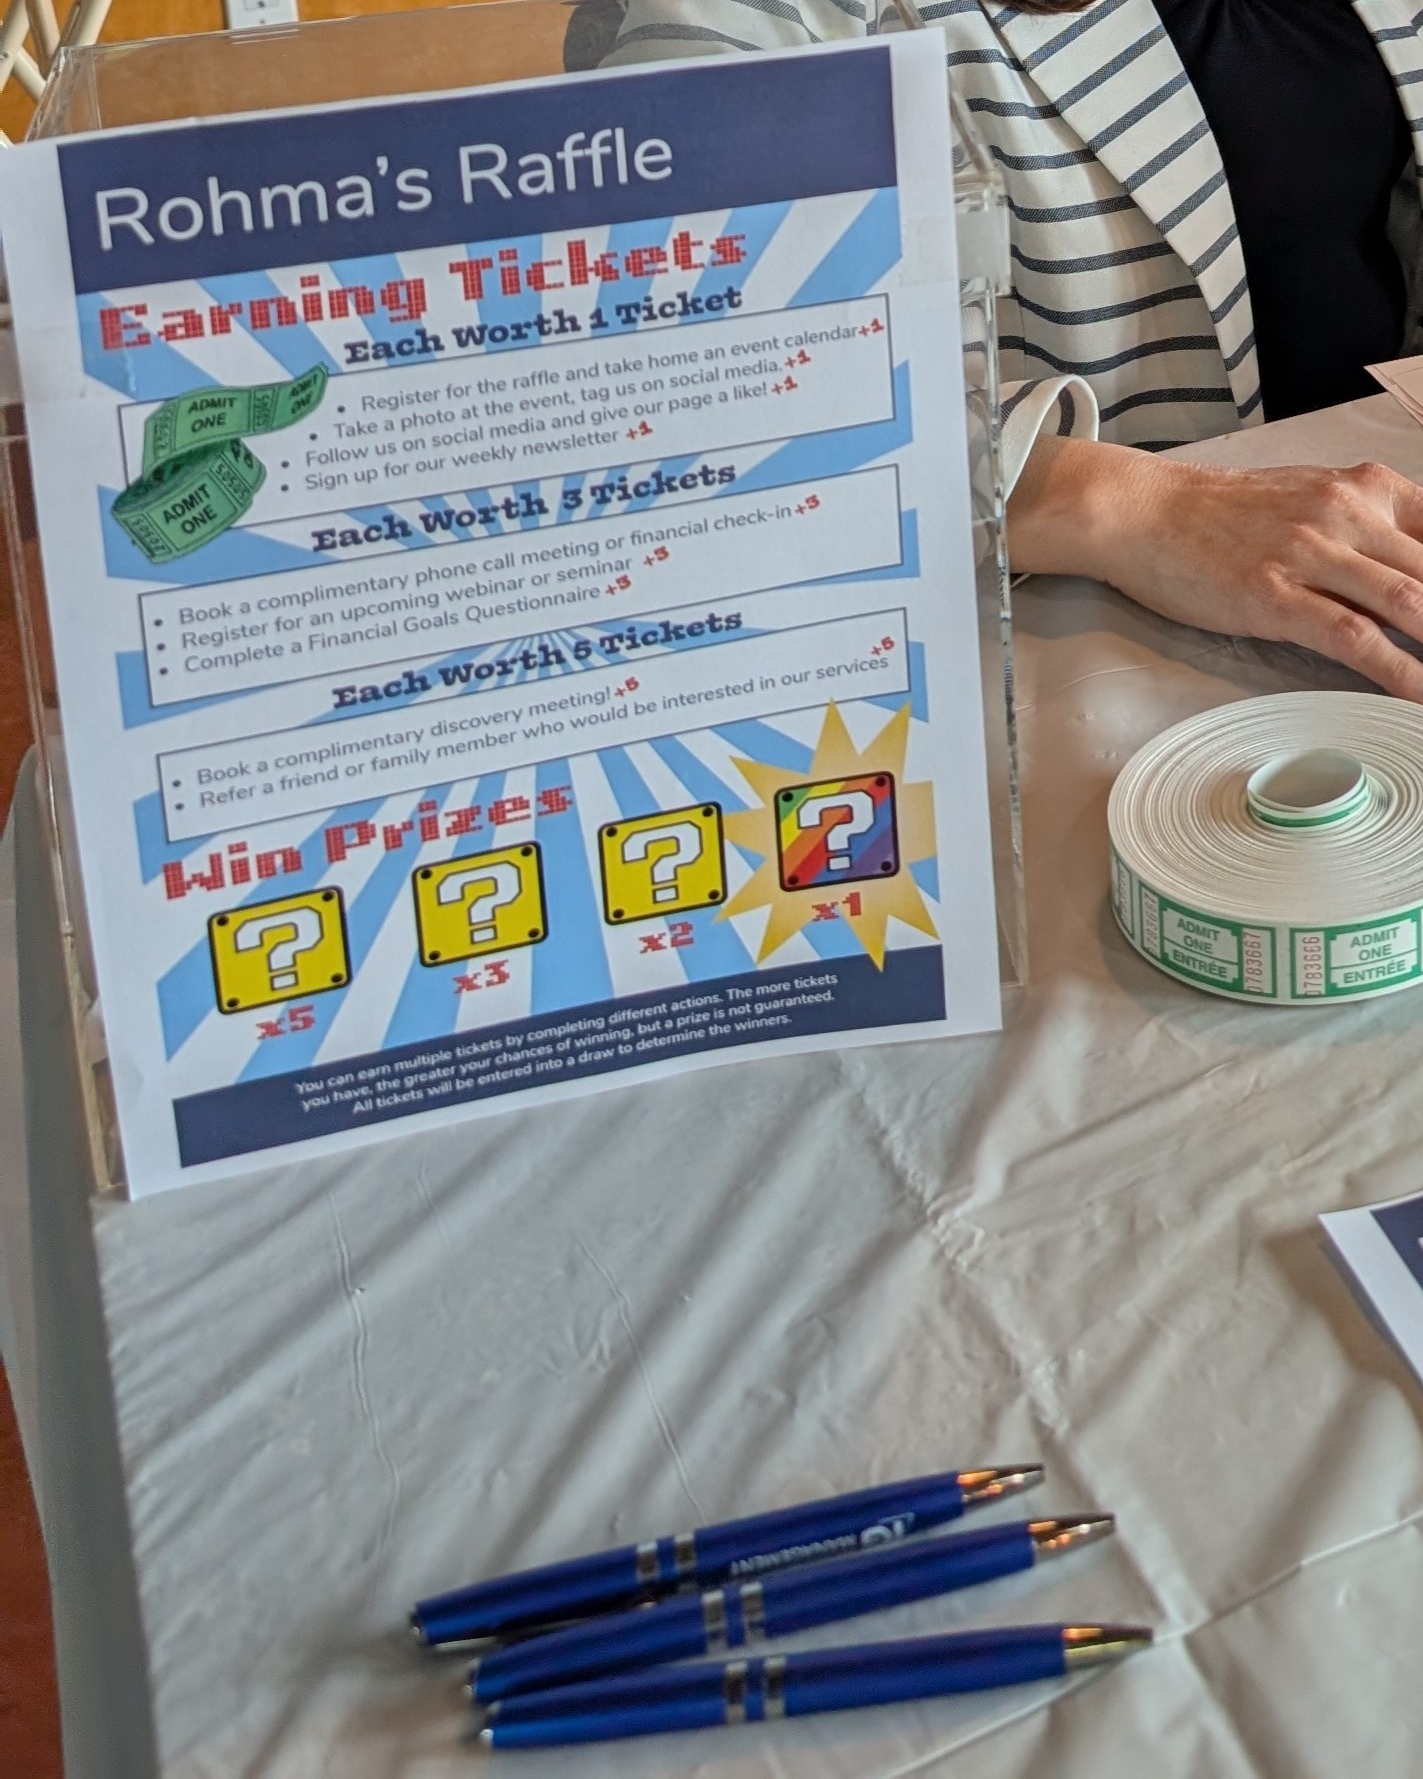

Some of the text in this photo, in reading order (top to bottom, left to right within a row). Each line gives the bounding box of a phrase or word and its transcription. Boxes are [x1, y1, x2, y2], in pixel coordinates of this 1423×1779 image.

[95, 127, 673, 250] Rohma's Raffle
[99, 231, 747, 351] Earning Tickets
[344, 285, 742, 365] Each Worth 1 Ticket
[332, 357, 787, 440] Take a photo at the event, tag us on social media.
[360, 324, 859, 413] Register for the raffle and take home an event calendar
[188, 397, 237, 414] ADMIT
[191, 412, 228, 433] ONE
[304, 380, 768, 468] Follow us on social media and give our page a like!
[303, 429, 620, 492] Sign up for our weekly newsletter
[162, 483, 211, 523] ADMIT
[181, 505, 218, 535] ONE
[311, 464, 736, 553] Each Worth 3 Tickets
[178, 504, 793, 626] Book a complimentary phone call meeting or financial check-in
[180, 557, 634, 650] Register for an upcoming webinar or seminar
[183, 585, 602, 674] Complete a Financial Goals Questionnaire
[332, 613, 742, 710] Each Worth 5 Tickets
[196, 685, 612, 787] Book a complimentary discovery meeting!
[198, 650, 890, 809] Refer a friend or family member who would be interested in our services
[162, 785, 572, 901] Win Prizes
[638, 921, 694, 954] x2
[812, 891, 864, 922] x1
[1176, 918, 1220, 941] ADMIT
[1350, 926, 1399, 948] ADMIT
[1173, 947, 1228, 979] ENTRÉE
[1183, 936, 1214, 954] ONE
[1243, 931, 1263, 993] 0783667
[1302, 936, 1323, 996] 0783666
[1343, 959, 1406, 984] ENTRÉE
[1358, 943, 1393, 961] ONE
[453, 960, 511, 994] x3
[257, 1005, 316, 1040] x5
[351, 1013, 794, 1115] All tickets will be entered into a draw to determine the winners.
